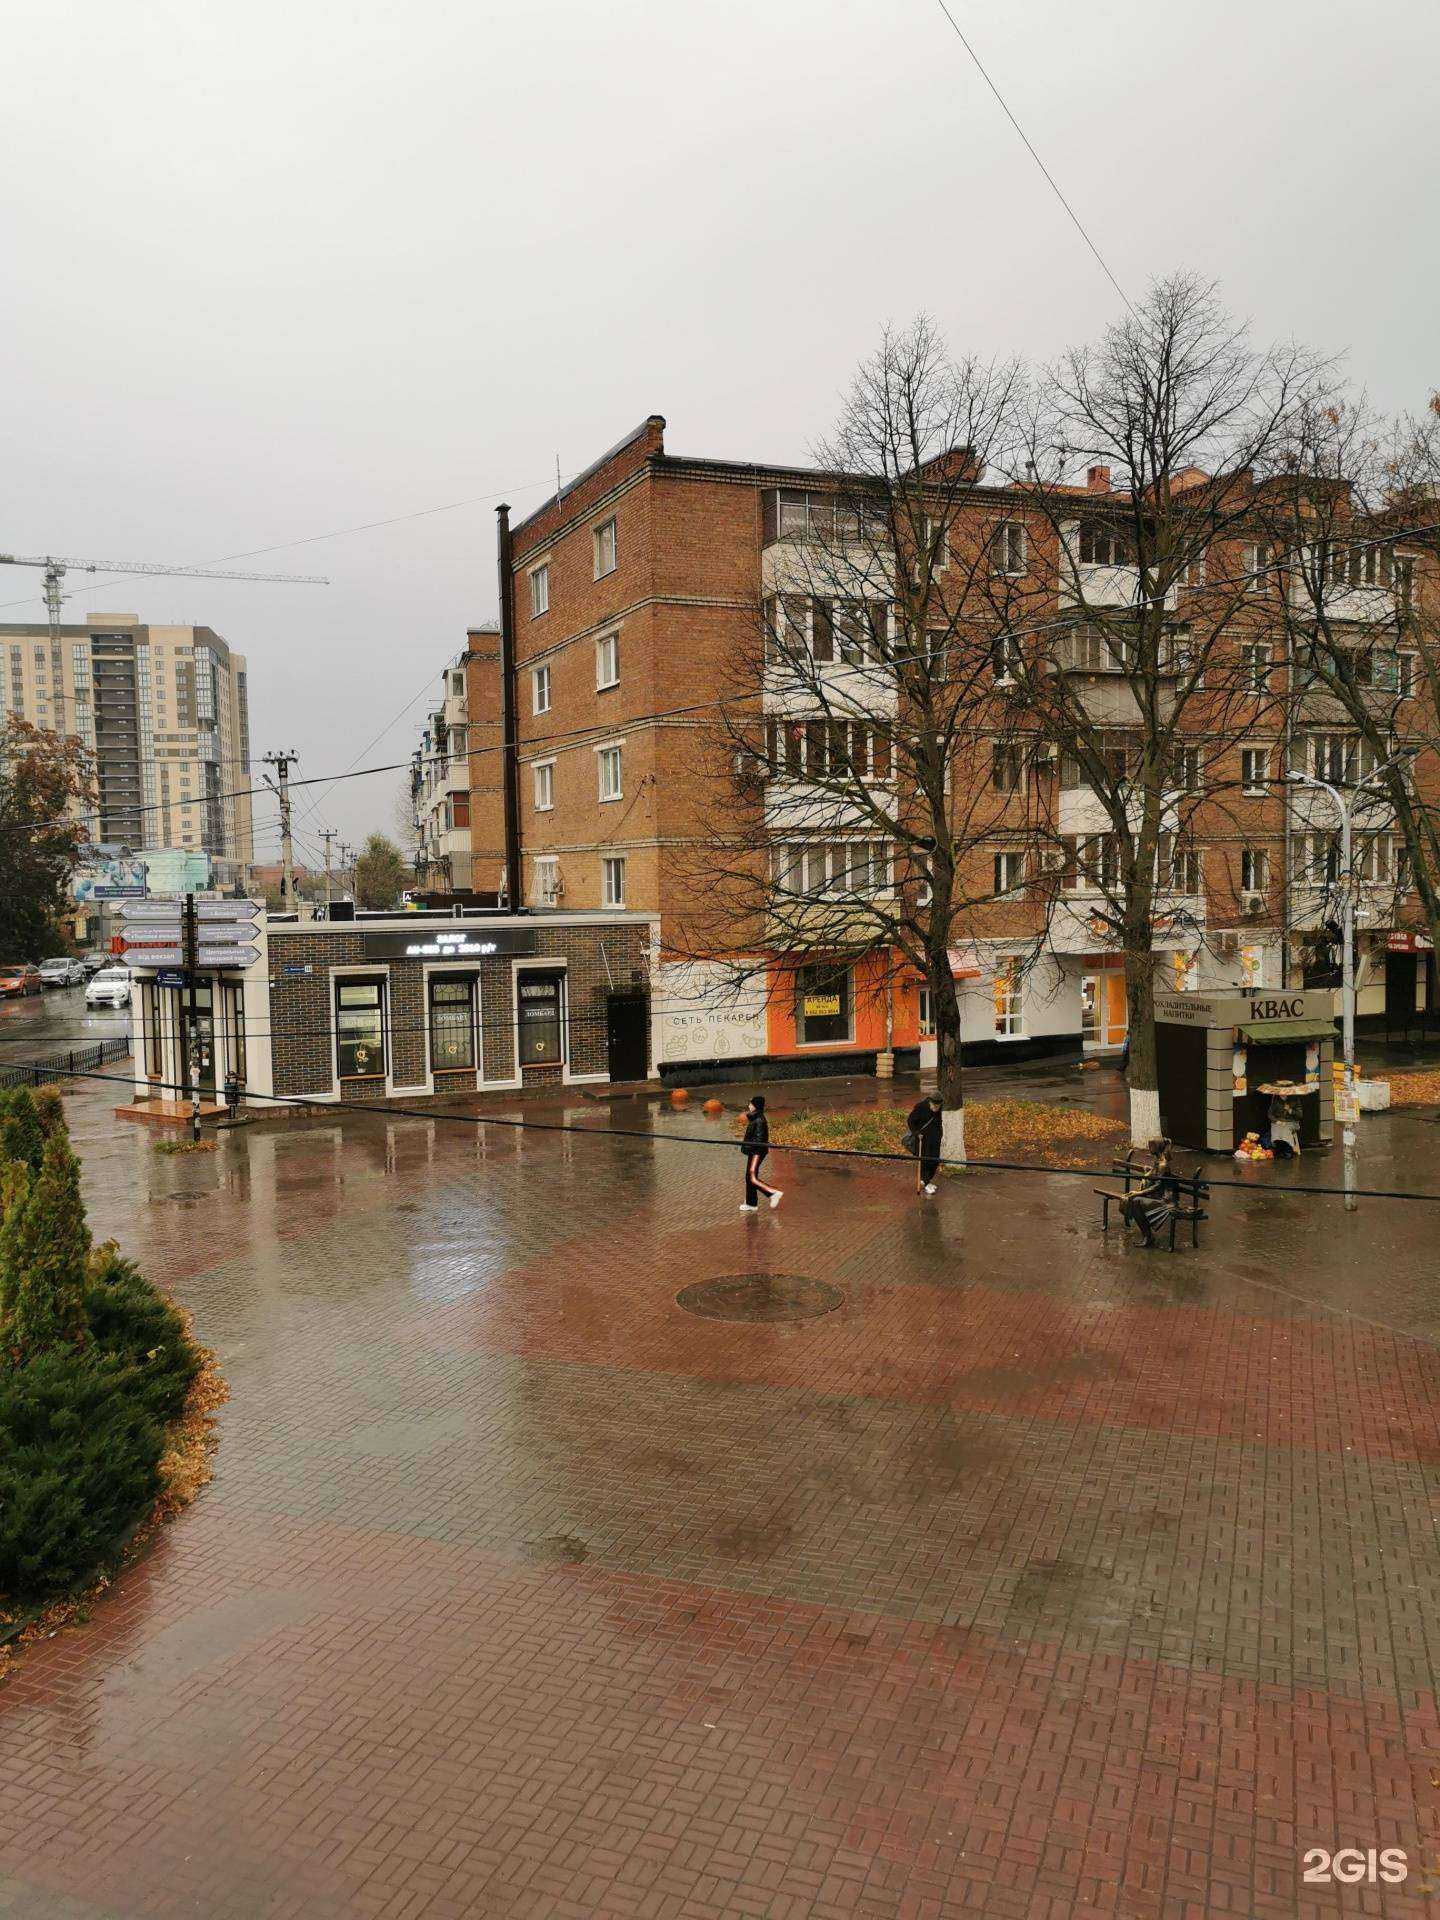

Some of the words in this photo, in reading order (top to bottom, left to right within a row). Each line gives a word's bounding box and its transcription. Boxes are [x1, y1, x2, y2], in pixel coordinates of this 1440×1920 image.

[1152, 1000, 1213, 1013] РОХЛАДИТЕЛЬНЫЕ
[1250, 998, 1304, 1020] КВАС
[1163, 1009, 1195, 1020] НАПИТКИ
[673, 1016, 702, 1026] СЕТЬ
